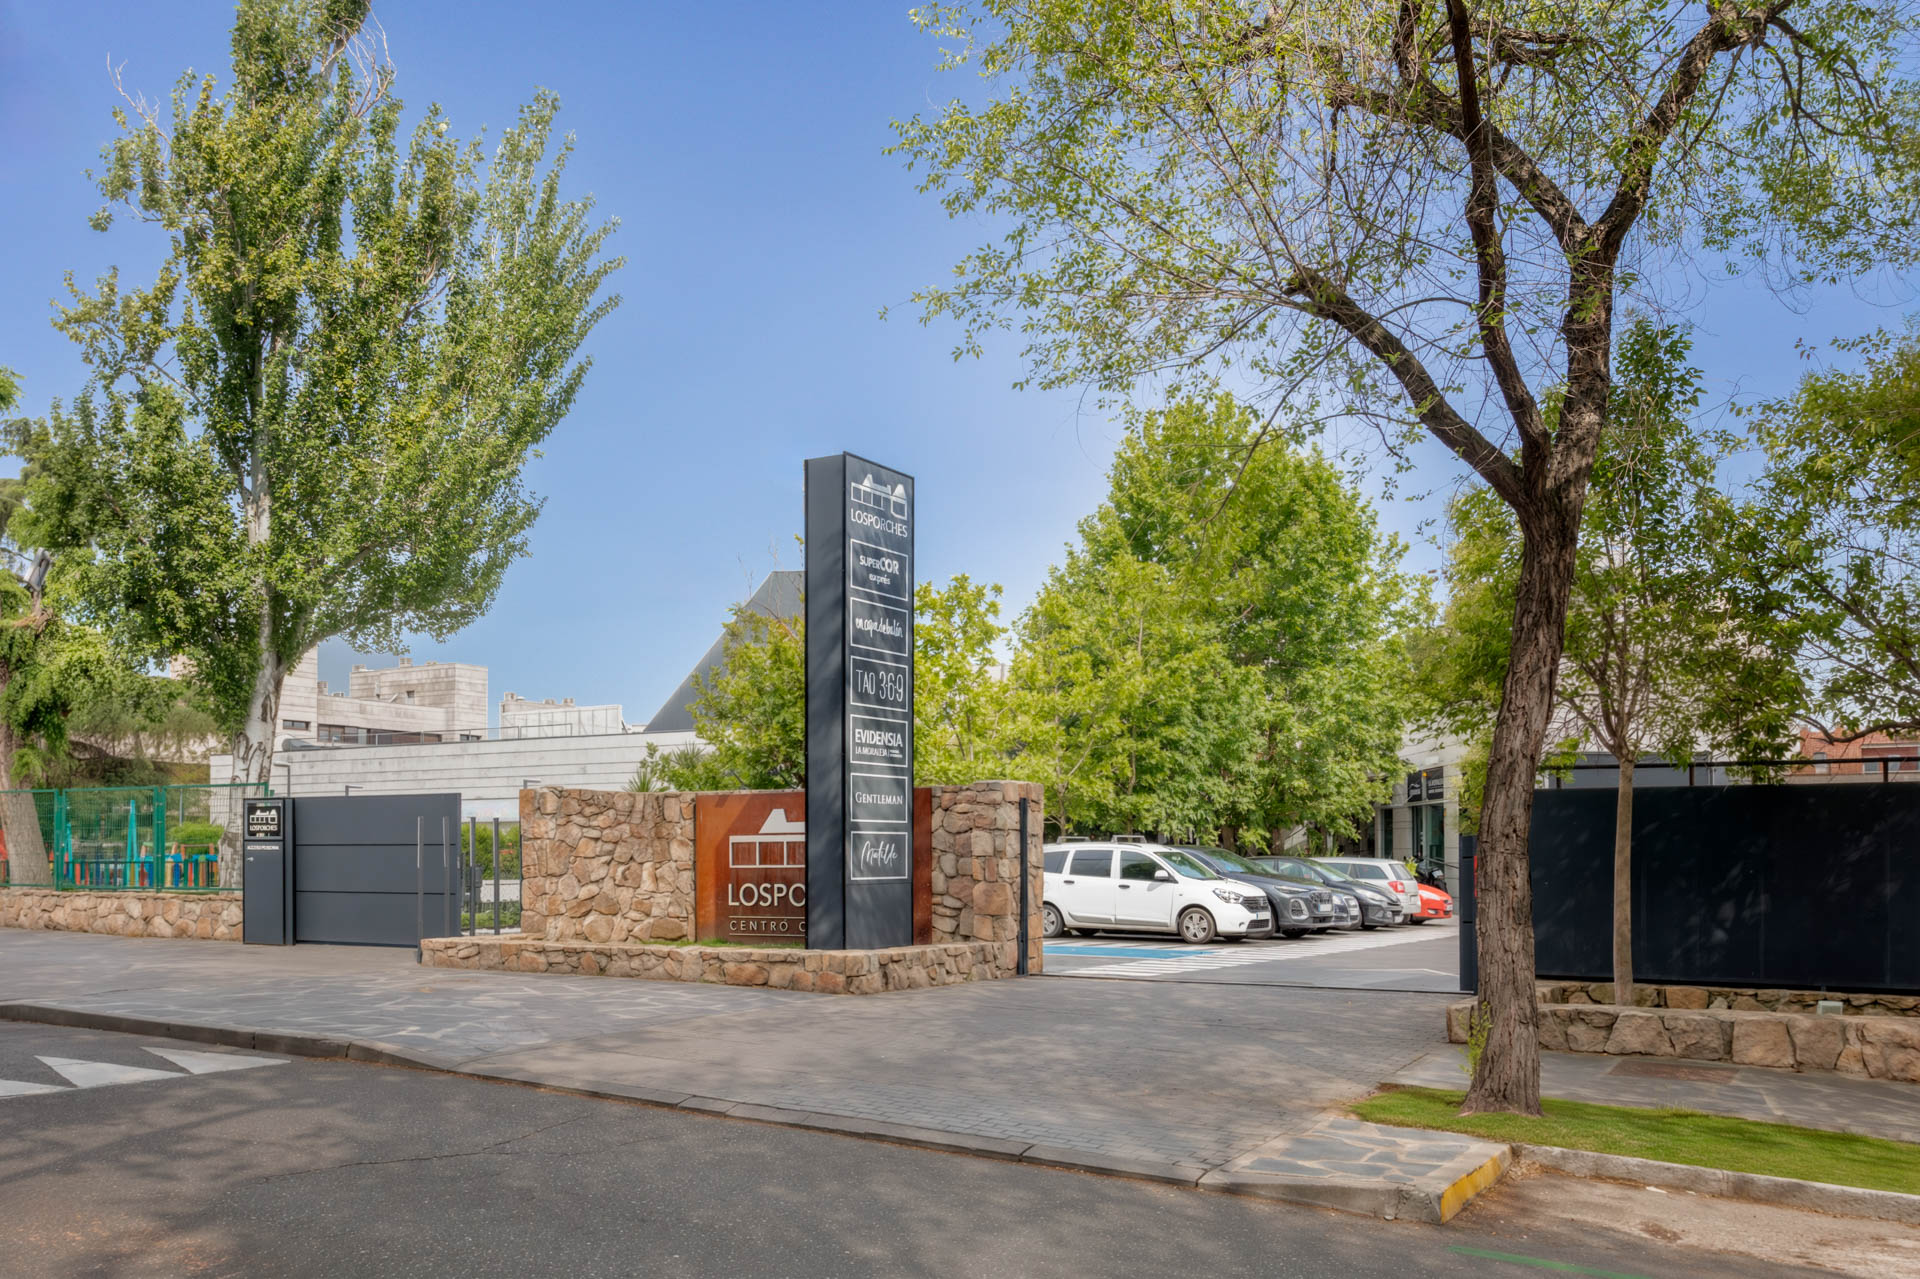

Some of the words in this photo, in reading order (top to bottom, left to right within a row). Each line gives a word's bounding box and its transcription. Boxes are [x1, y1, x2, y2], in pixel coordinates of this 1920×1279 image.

[850, 508, 908, 538] LOSPORCHES
[855, 669, 876, 695] TAO
[855, 728, 903, 748] EVIDENSIA
[855, 746, 861, 754] LA
